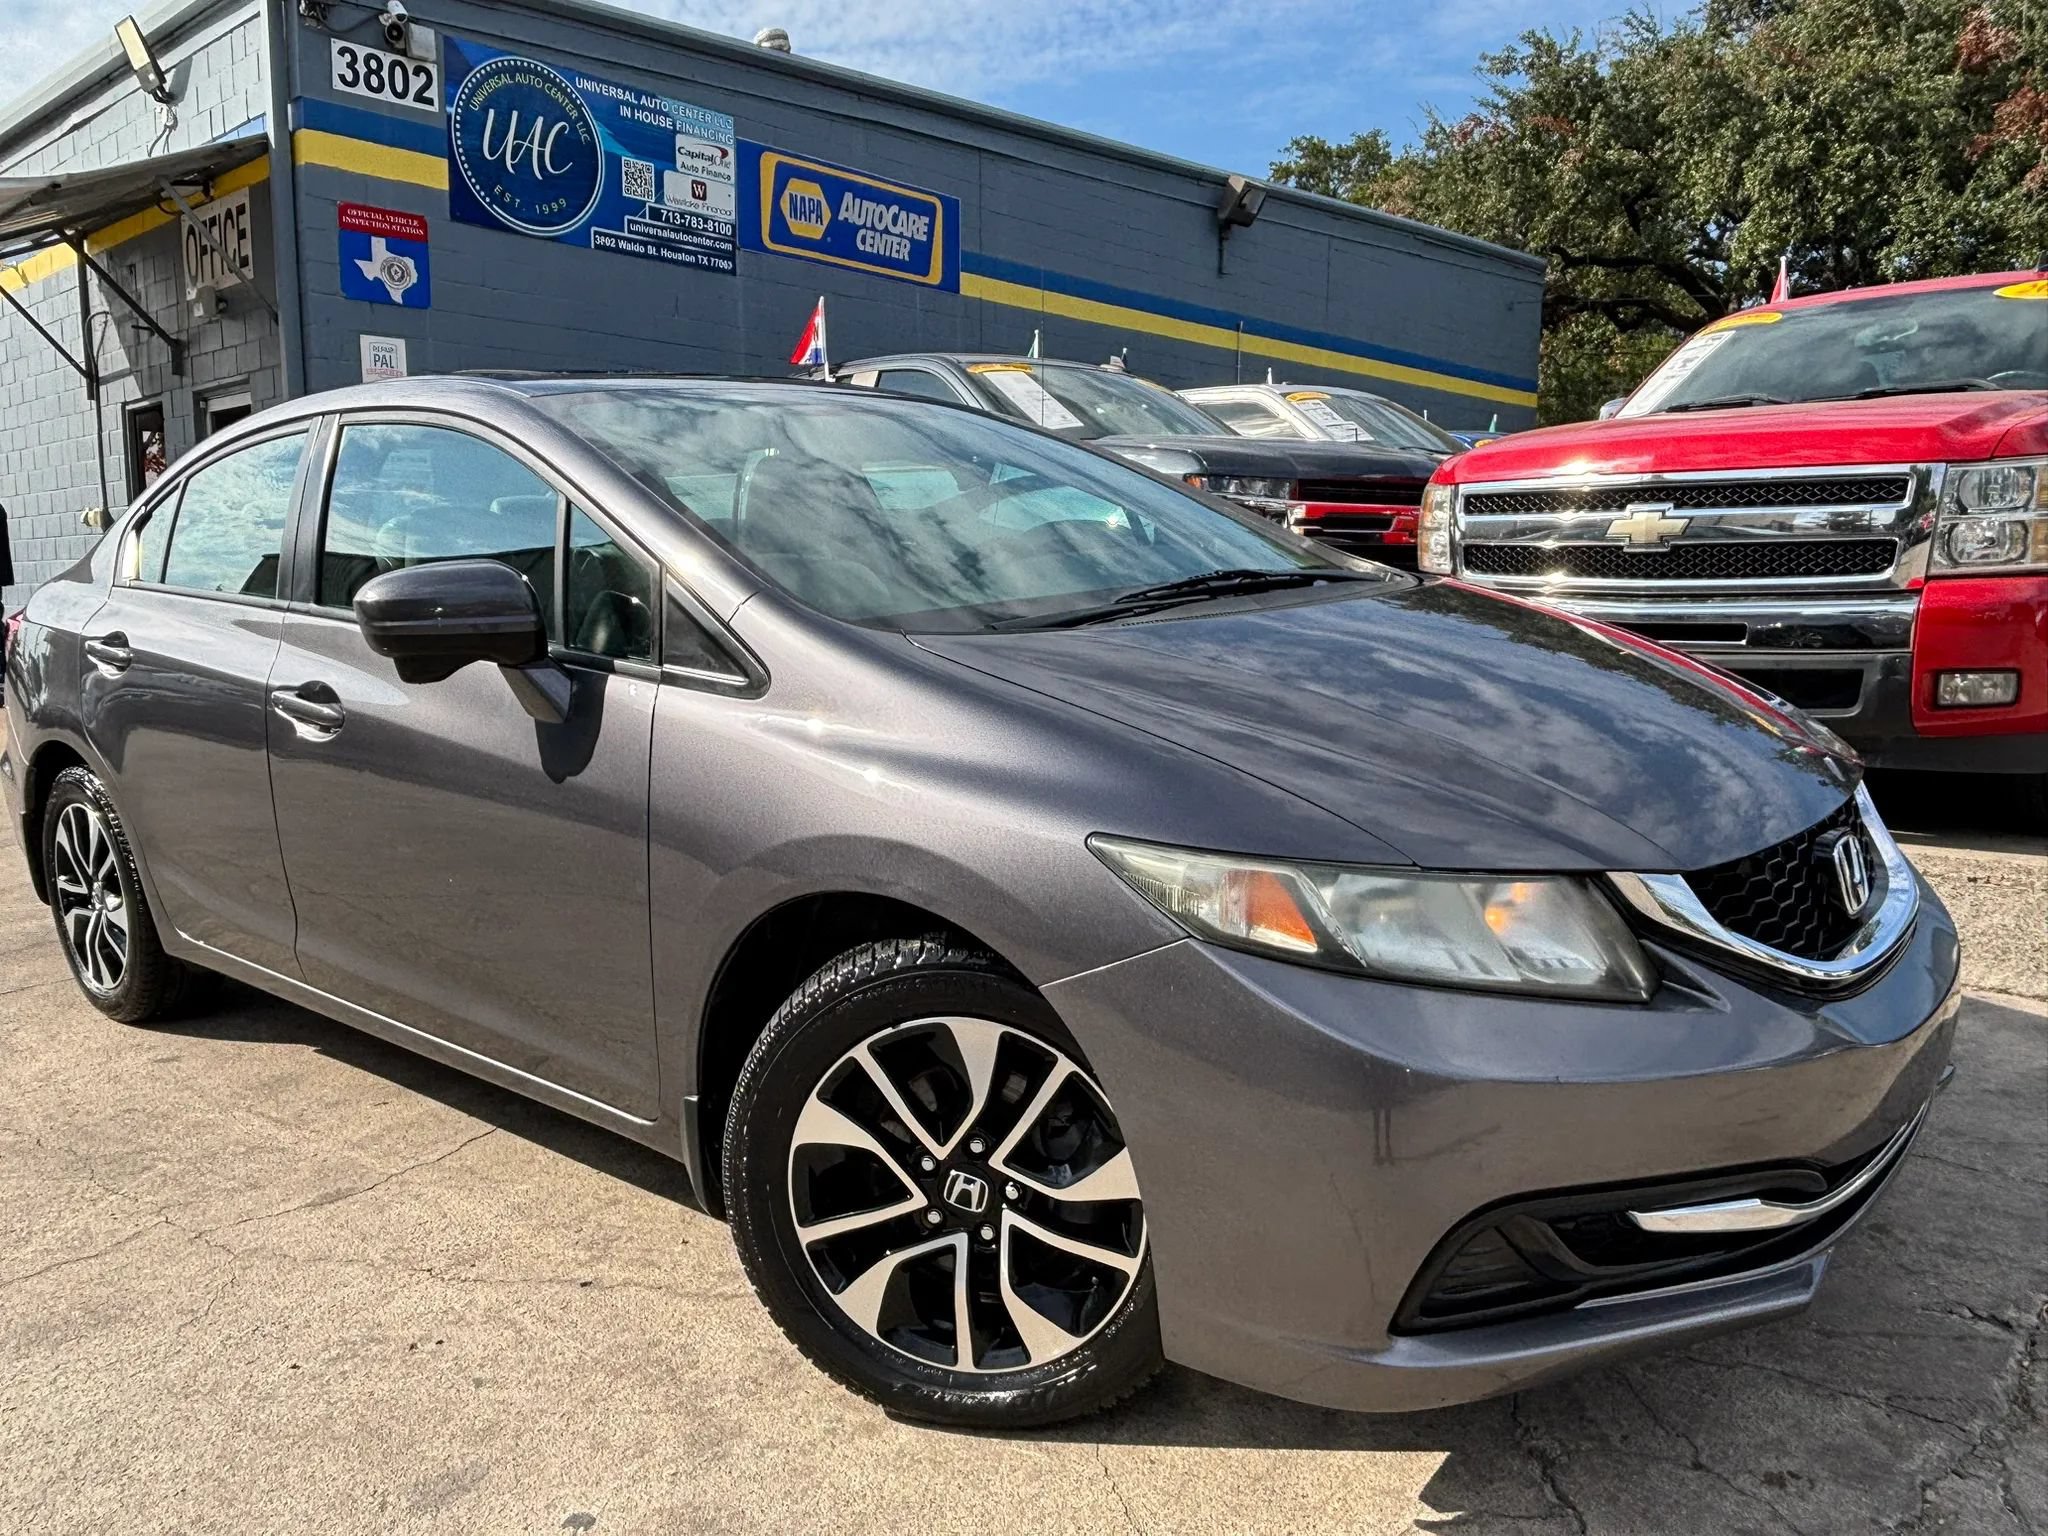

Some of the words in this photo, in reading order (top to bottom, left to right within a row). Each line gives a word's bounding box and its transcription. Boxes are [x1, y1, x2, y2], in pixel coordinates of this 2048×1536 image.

[336, 45, 435, 107] 3802
[469, 72, 514, 111] UNIVERSAL
[515, 72, 543, 89] AUTO
[544, 83, 579, 120] CENTER
[575, 121, 592, 145] LLC
[575, 76, 638, 104] UNIVERSAL
[640, 97, 669, 112] AUTO
[671, 104, 712, 123] CENTER
[713, 116, 733, 129] LLC
[619, 105, 631, 119] IN
[634, 107, 673, 129] HOUSE
[676, 120, 734, 145] FINANCING
[482, 108, 573, 181] UAC
[680, 161, 699, 174] Auto
[701, 166, 732, 181] Finance
[347, 208, 385, 221] OFFICIAL
[535, 198, 567, 215] 1999
[660, 209, 732, 236] 713-783-8100
[788, 192, 824, 226] NAPA
[342, 215, 390, 229] INSPECTION
[391, 224, 425, 236] STATION
[630, 222, 733, 251] universalautocenter.com
[185, 202, 250, 288] OFFICE
[595, 234, 616, 248] 3802
[617, 239, 645, 253] Waldo
[660, 247, 696, 264] Houston
[697, 255, 709, 266] TX
[855, 228, 912, 262] CENTER
[373, 353, 395, 369] PAL
